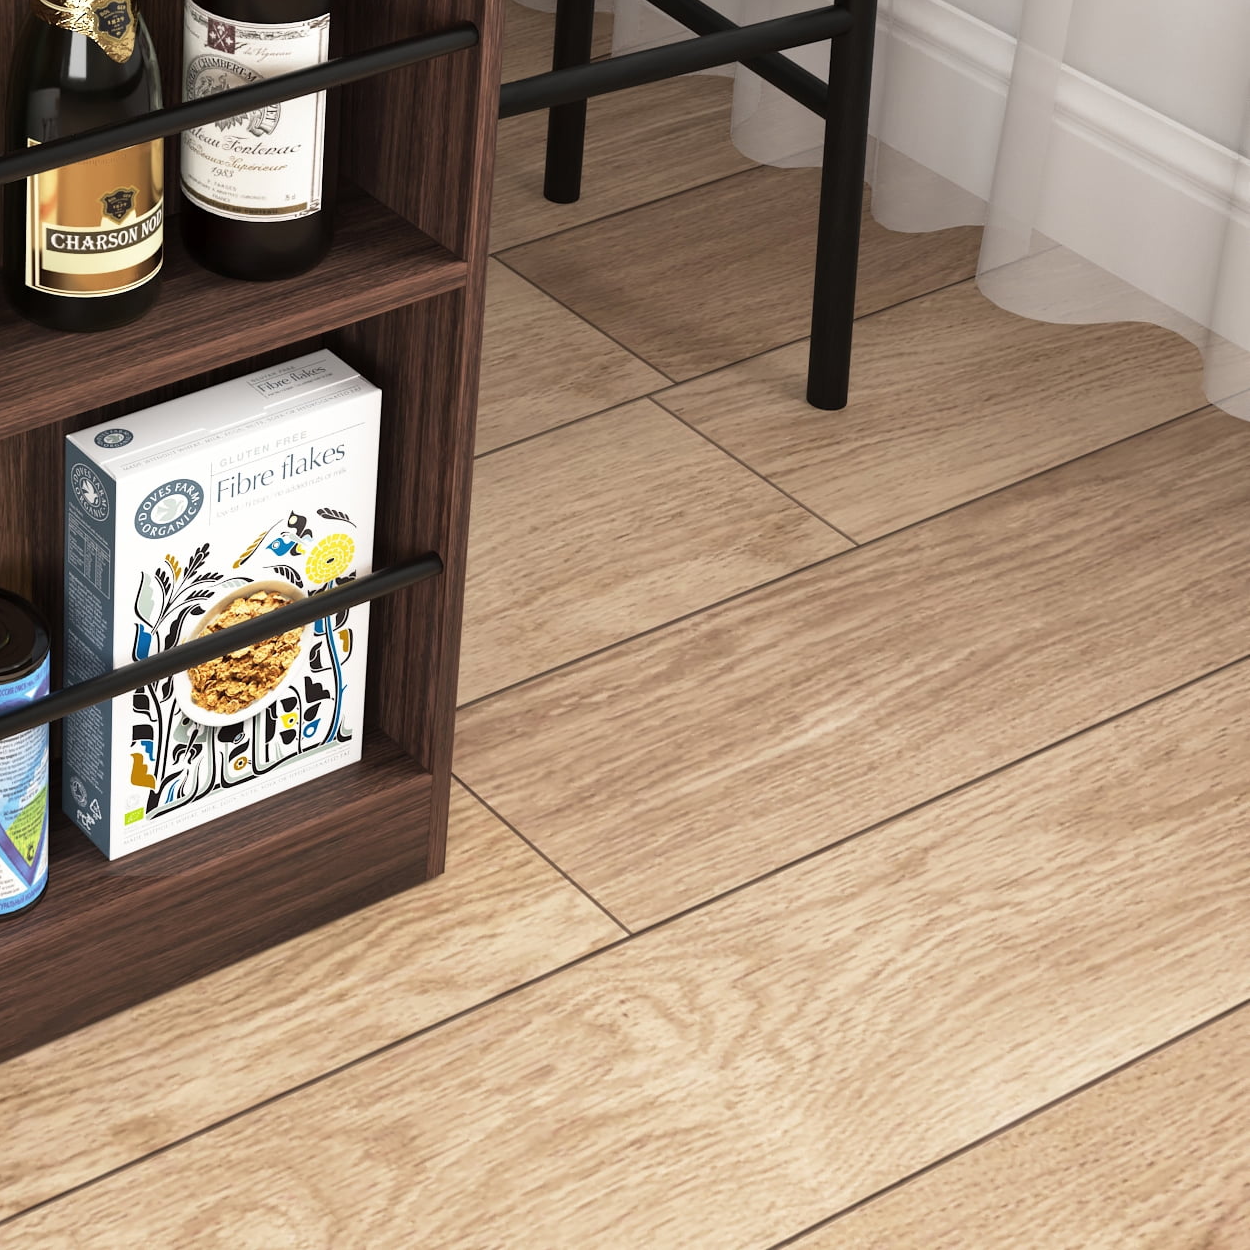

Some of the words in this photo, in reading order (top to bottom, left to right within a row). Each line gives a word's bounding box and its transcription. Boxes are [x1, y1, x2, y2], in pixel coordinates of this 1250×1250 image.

[50, 227, 139, 251] CHARSON
[257, 377, 290, 393] Fibre
[290, 366, 327, 382] flakes
[219, 443, 270, 468] GLUTEN
[276, 431, 308, 449] FREE
[217, 469, 275, 503] Fibre
[281, 443, 346, 480] flakes
[138, 484, 172, 522] DOVES
[174, 482, 201, 502] FARM
[141, 506, 198, 537] ORGANIC
